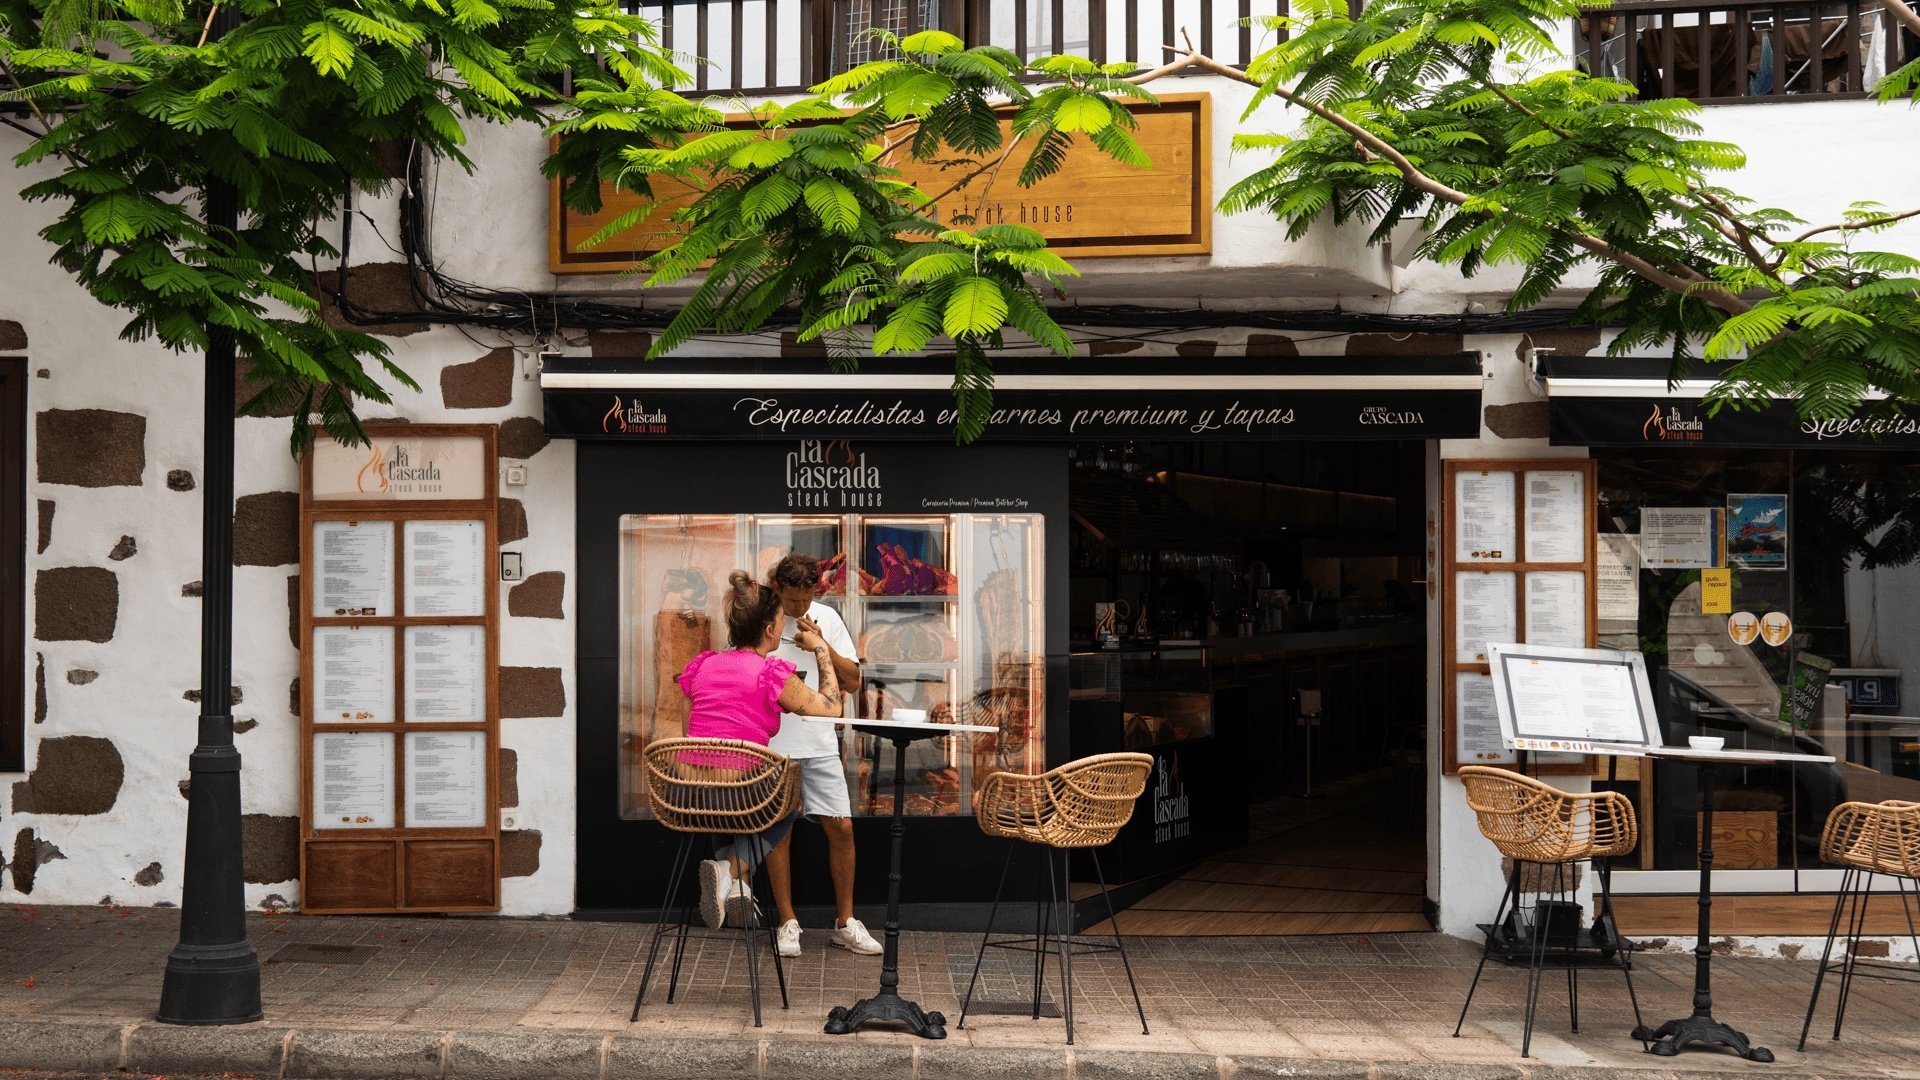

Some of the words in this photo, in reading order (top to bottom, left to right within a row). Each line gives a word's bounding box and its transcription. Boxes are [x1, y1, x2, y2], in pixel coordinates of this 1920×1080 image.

[1020, 202, 1072, 223] house
[633, 398, 643, 414] la
[1671, 406, 1681, 421] la
[627, 407, 667, 424] Cascada
[734, 397, 926, 432] Especialistas
[977, 408, 1062, 425] arnes
[1069, 404, 1188, 433] premium
[1190, 408, 1221, 434] y
[1223, 400, 1295, 432] tapas
[1359, 412, 1424, 425] CASCADA
[1666, 415, 1703, 431] Cascada
[628, 424, 646, 433] steak
[649, 424, 667, 433] house
[1801, 412, 1920, 440] Specialis
[395, 444, 409, 467] la
[389, 460, 441, 481] Cascada
[786, 451, 882, 489] Cascada
[390, 483, 413, 493] steak
[419, 483, 442, 493] house
[787, 490, 829, 507] steak
[841, 490, 882, 507] house
[1014, 498, 1029, 509] Shop
[1157, 755, 1168, 797] la
[1154, 782, 1189, 825] Cascada
